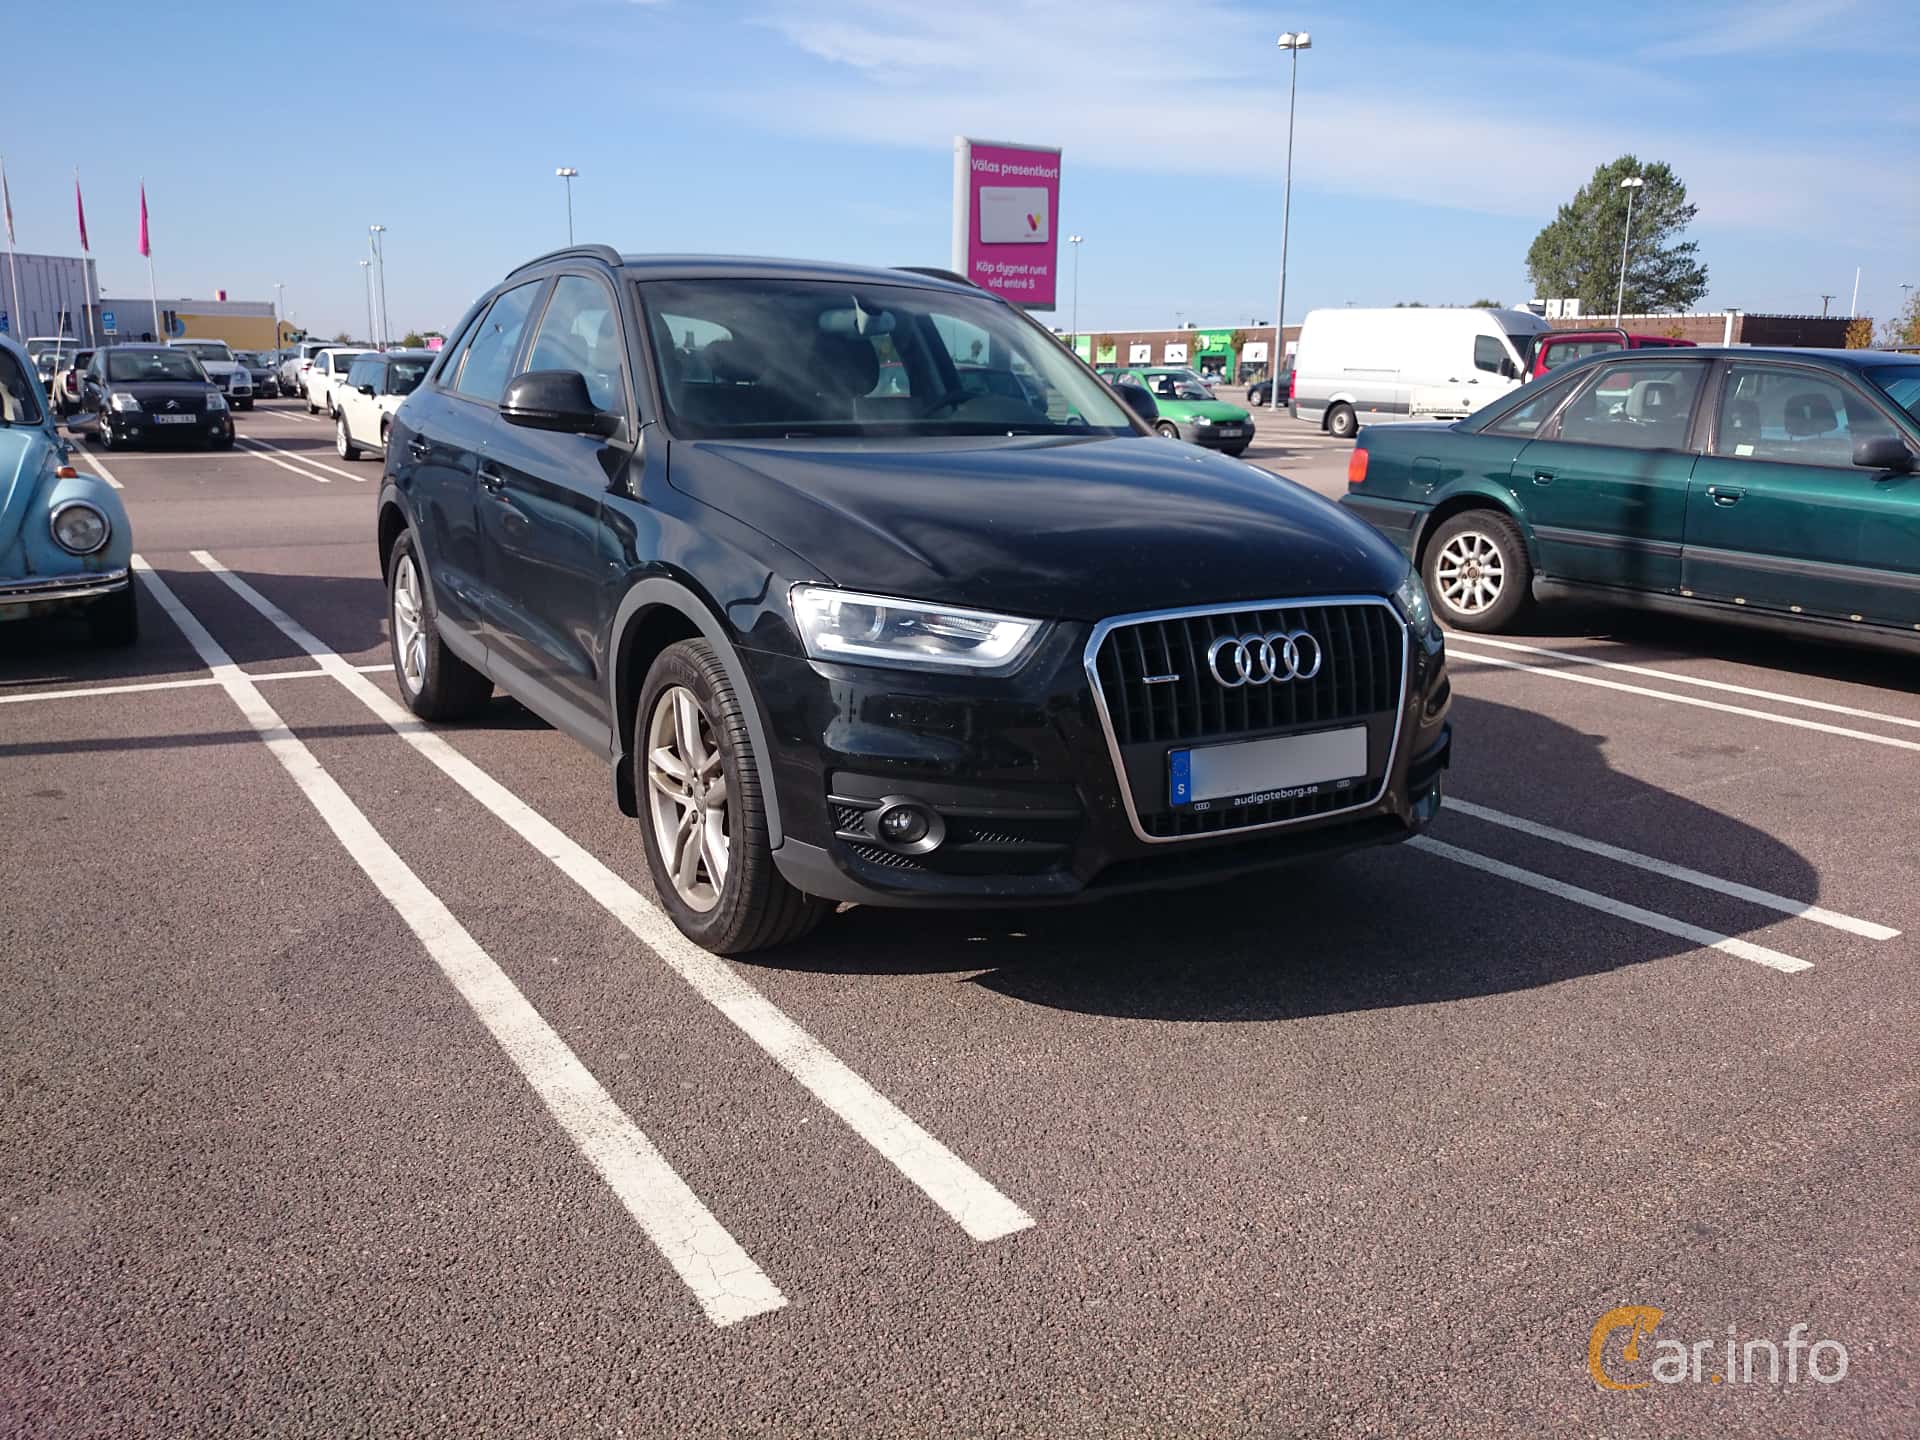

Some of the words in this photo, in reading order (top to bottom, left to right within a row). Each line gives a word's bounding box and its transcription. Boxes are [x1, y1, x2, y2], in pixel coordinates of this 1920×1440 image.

[971, 159, 1000, 173] Välas
[1001, 163, 1059, 179] presentkort
[976, 261, 995, 274] Köp
[996, 262, 1028, 276] dygnet
[1029, 265, 1047, 276] runt
[988, 277, 1003, 288] vid
[1004, 278, 1027, 289] entré
[1177, 783, 1185, 795] S
[1233, 785, 1319, 807] audigoteborg.se
